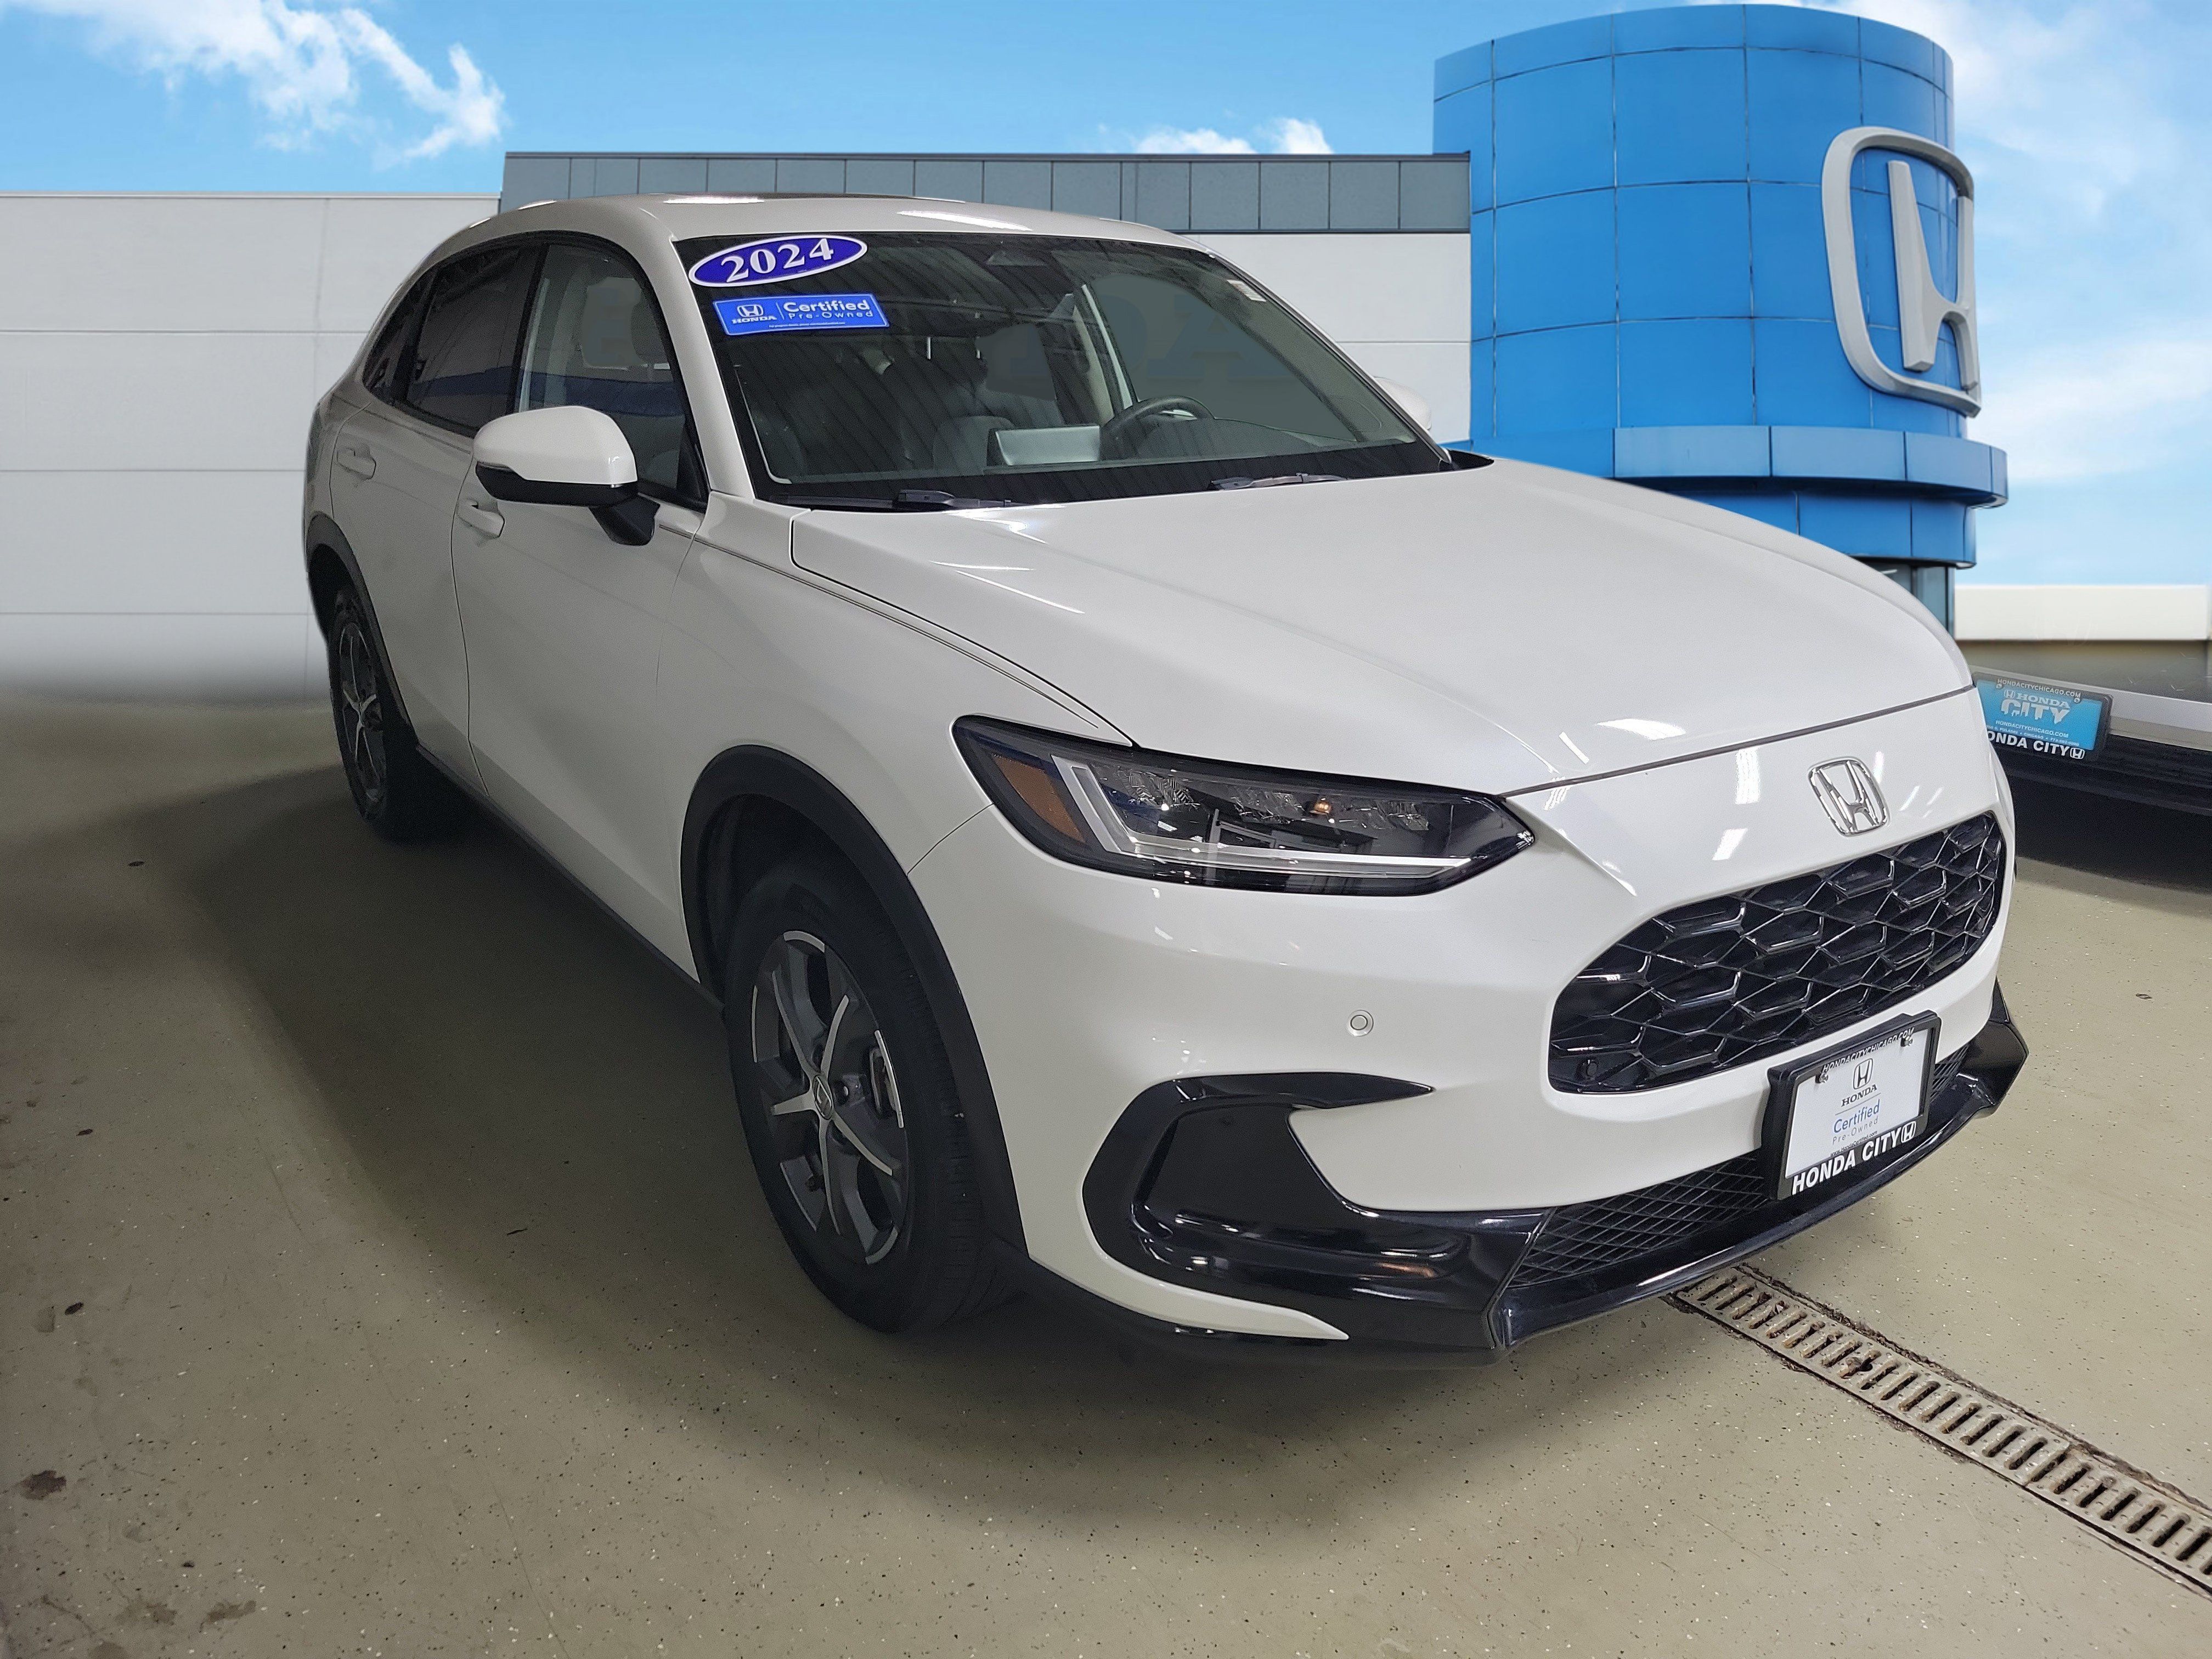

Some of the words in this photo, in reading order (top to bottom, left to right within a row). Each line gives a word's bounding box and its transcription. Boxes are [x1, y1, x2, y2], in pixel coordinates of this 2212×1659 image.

[720, 238, 834, 283] 2024
[783, 299, 870, 312] Certified
[788, 311, 873, 319] Pre-Owned
[731, 315, 777, 324] HONDA
[1997, 679, 2081, 698] HONDACITYCHICAGO.COM
[2016, 692, 2071, 708] HONDA
[2001, 699, 2070, 724] CITY
[1995, 720, 2069, 738] HONDACITYCHICAGO.COM
[1987, 731, 2028, 748] ONDA
[2033, 741, 2070, 756] CITY
[1822, 1028, 1915, 1073] HONDACITYCHICAGO.COM
[1841, 1084, 1877, 1107] HONDA
[1834, 1099, 1880, 1133] Certified
[1832, 1115, 1878, 1145] Pre-Owned
[1792, 1149, 1856, 1195] HONDA
[1862, 1127, 1902, 1161] CITY
